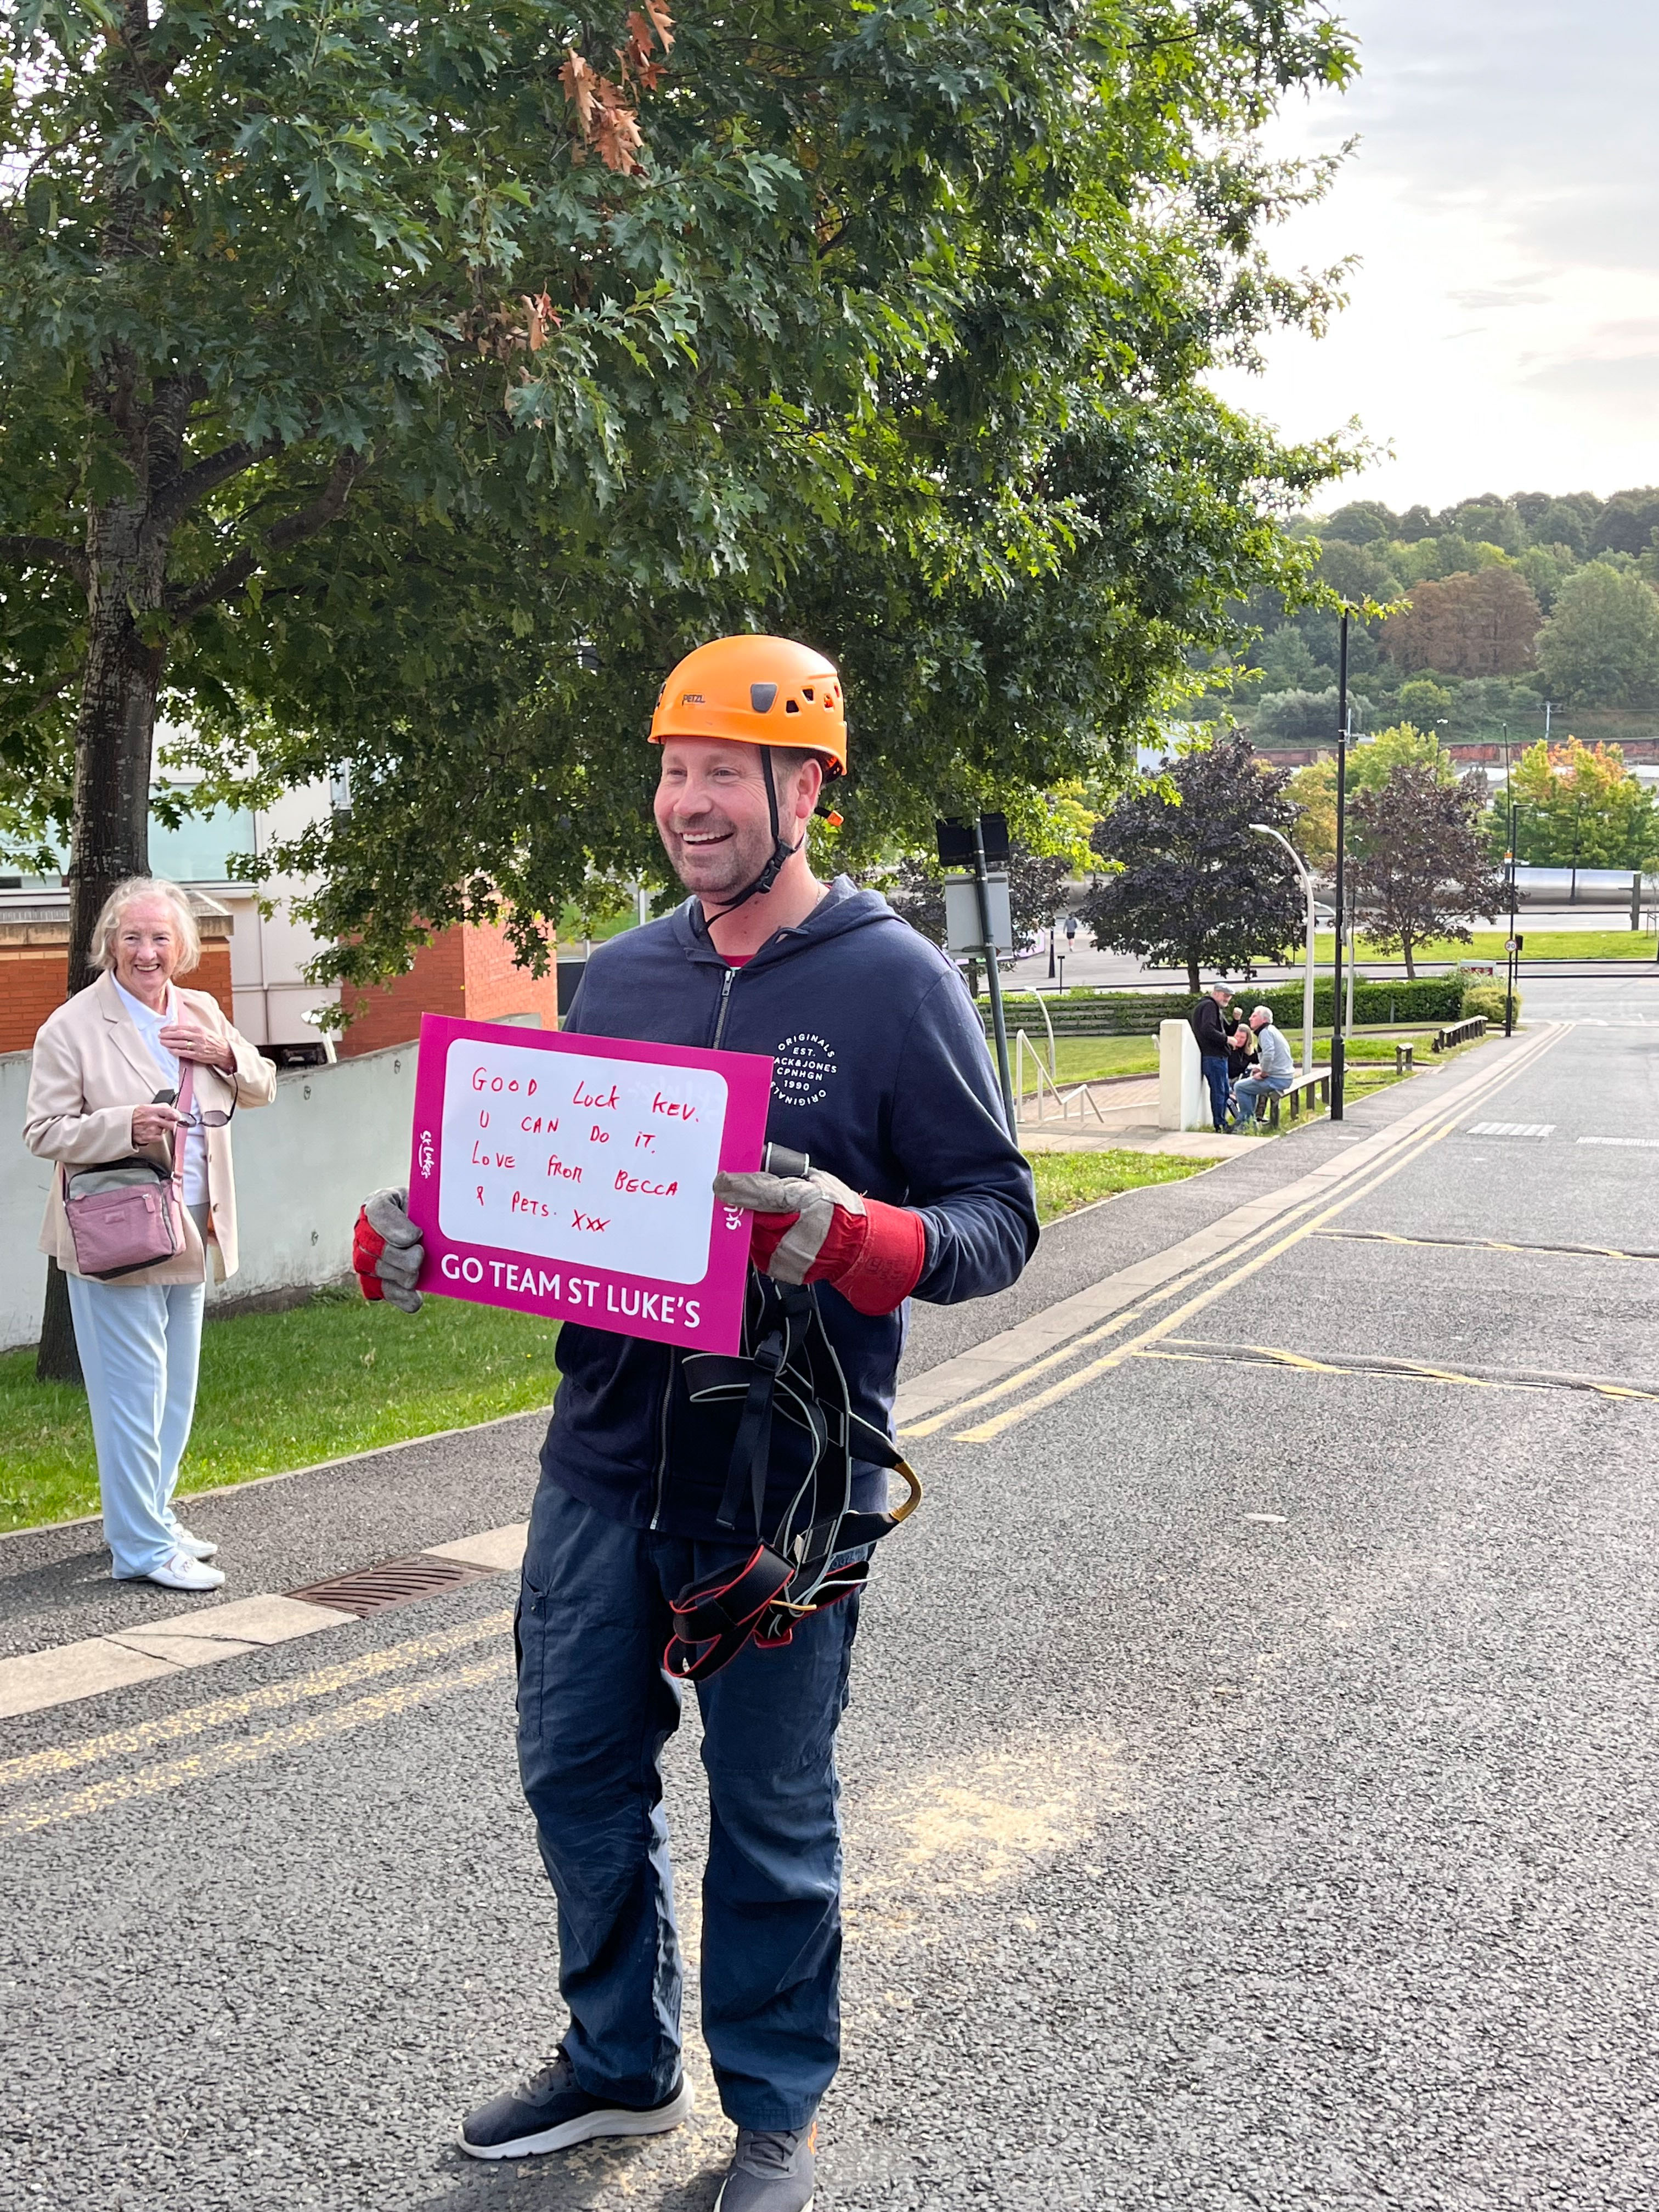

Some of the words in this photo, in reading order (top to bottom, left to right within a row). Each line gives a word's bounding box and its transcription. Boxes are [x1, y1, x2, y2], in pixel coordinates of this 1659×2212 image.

[681, 694, 706, 706] PETZL
[778, 1034, 835, 1057] ORIGINALS
[793, 1047, 816, 1057] EST.
[774, 1057, 837, 1073] ACK&JONES
[776, 1067, 823, 1081] CPNHGN
[472, 1066, 538, 1096] GOOD
[784, 1080, 810, 1091] 1990
[479, 1110, 489, 1128] U
[521, 1116, 558, 1133] CAN
[590, 1125, 610, 1143] DO
[472, 1140, 516, 1168] LOVE
[614, 1169, 678, 1196] BECCA
[441, 1254, 483, 1283] GO
[489, 1261, 560, 1300] TEAM
[568, 1278, 600, 1307] ST
[607, 1284, 701, 1328] LUKE'S
